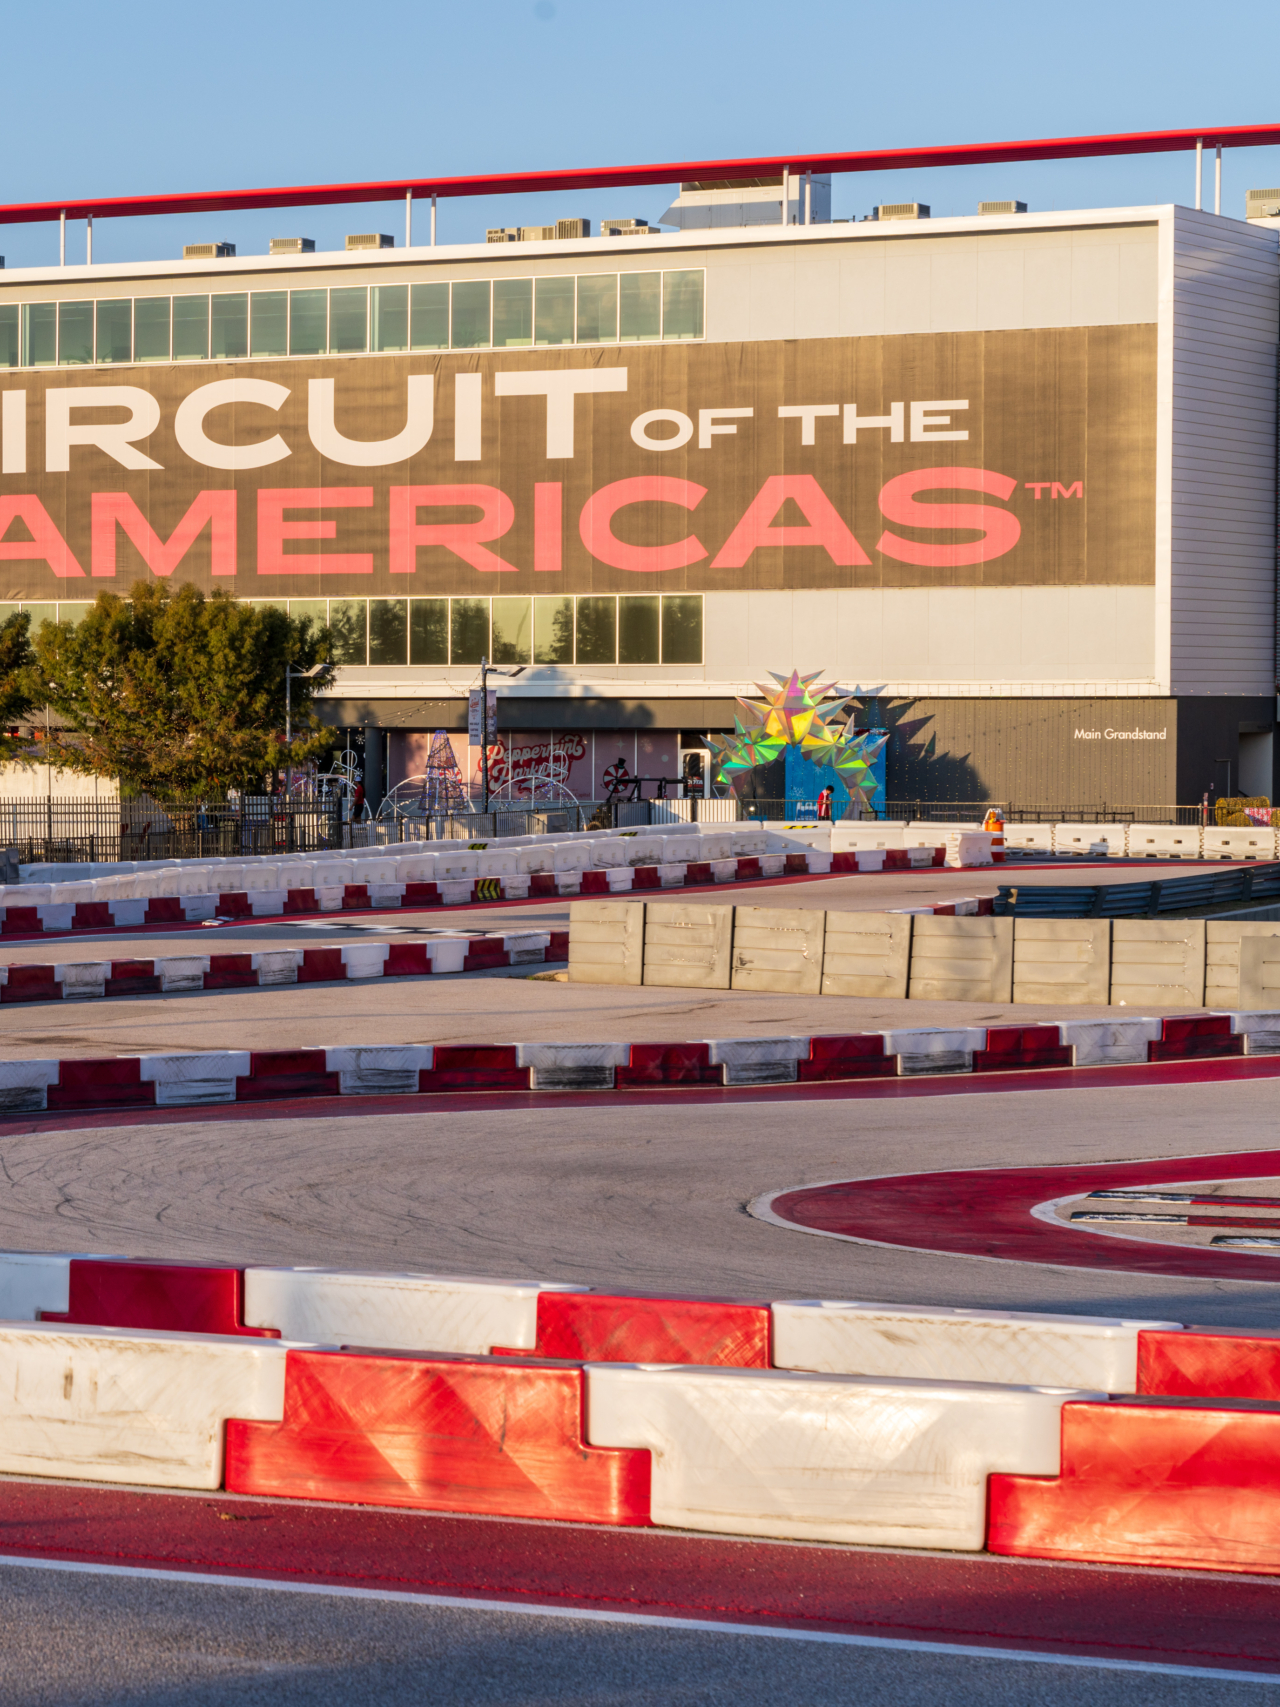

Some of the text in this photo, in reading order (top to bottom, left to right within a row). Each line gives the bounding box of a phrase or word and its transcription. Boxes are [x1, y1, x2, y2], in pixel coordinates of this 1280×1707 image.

[629, 407, 755, 453] OF
[776, 399, 971, 447] THE
[1074, 727, 1167, 740] Main Grandstand
[480, 735, 583, 768] Peppermint
[489, 761, 569, 791] Parkway
